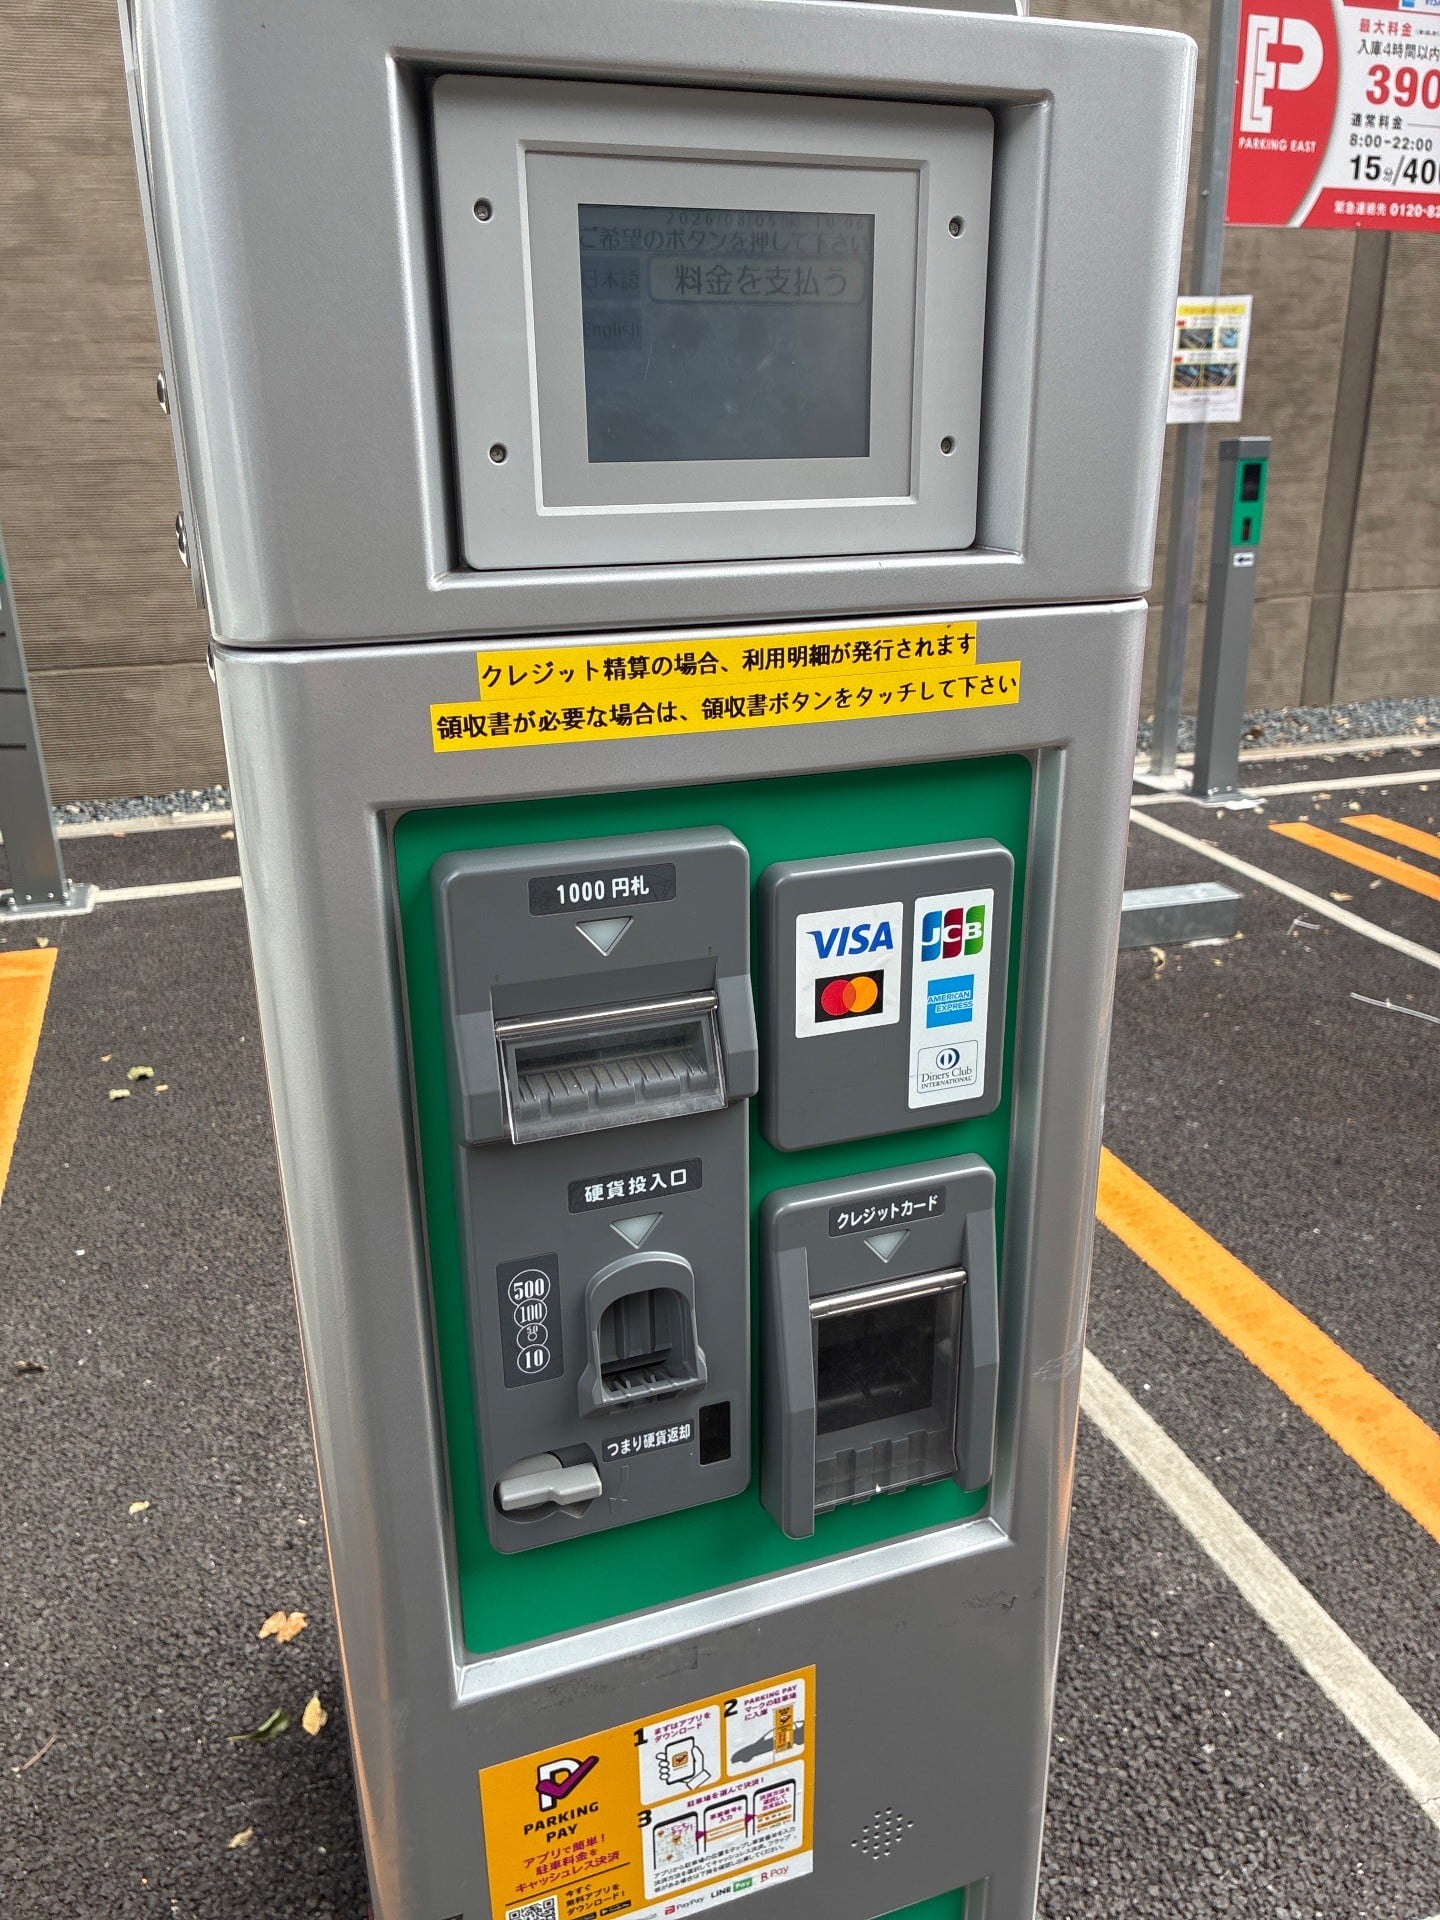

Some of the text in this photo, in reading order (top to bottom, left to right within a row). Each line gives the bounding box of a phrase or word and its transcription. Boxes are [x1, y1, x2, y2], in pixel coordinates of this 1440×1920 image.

[1360, 18, 1412, 37] 最大料金
[1357, 39, 1440, 61] 入庫4時間以内
[1366, 64, 1440, 110] 390
[1351, 112, 1402, 130] 通常料金
[1239, 137, 1316, 154] PARKING EAST
[580, 226, 867, 253] ご希望のボタンを押して下さい
[582, 269, 639, 290] 日本語
[675, 264, 847, 298] 料金を支払う
[480, 631, 977, 689] クレジット精算の場合、利用明細が発行されます
[436, 675, 1018, 740] 領収書が必要な場合は、領収書ボタンをタッチして下さい
[806, 921, 894, 959] VISA
[921, 910, 985, 953] JCB
[927, 990, 970, 1004] AMERICAN
[936, 1001, 973, 1013] EXPRESS
[921, 1066, 972, 1083] Diners Club
[921, 1076, 972, 1089] INTERNATIONAL
[584, 1168, 688, 1203] 硬貨投入口
[837, 1195, 938, 1229] クレジットカード
[513, 1277, 545, 1299] 500
[520, 1303, 542, 1323] 100
[525, 1352, 544, 1369] 10
[607, 1424, 691, 1457] つまり硬貨返却
[744, 1685, 798, 1705] PARKING PAY
[724, 1698, 738, 1718] 2
[654, 1711, 711, 1735] まずはアプリを
[654, 1722, 703, 1743] ダウンロード
[634, 1728, 648, 1747] 1
[523, 1802, 599, 1835] PARKING
[637, 1809, 652, 1828] 3
[546, 1824, 579, 1843] PAY
[515, 1851, 620, 1893] キャッシュレス決済
[536, 1849, 598, 1875] 駐車料金を
[770, 1866, 789, 1877] Pay
[566, 1884, 591, 1897] 今すぐ
[710, 1878, 752, 1899] LINE Pay
